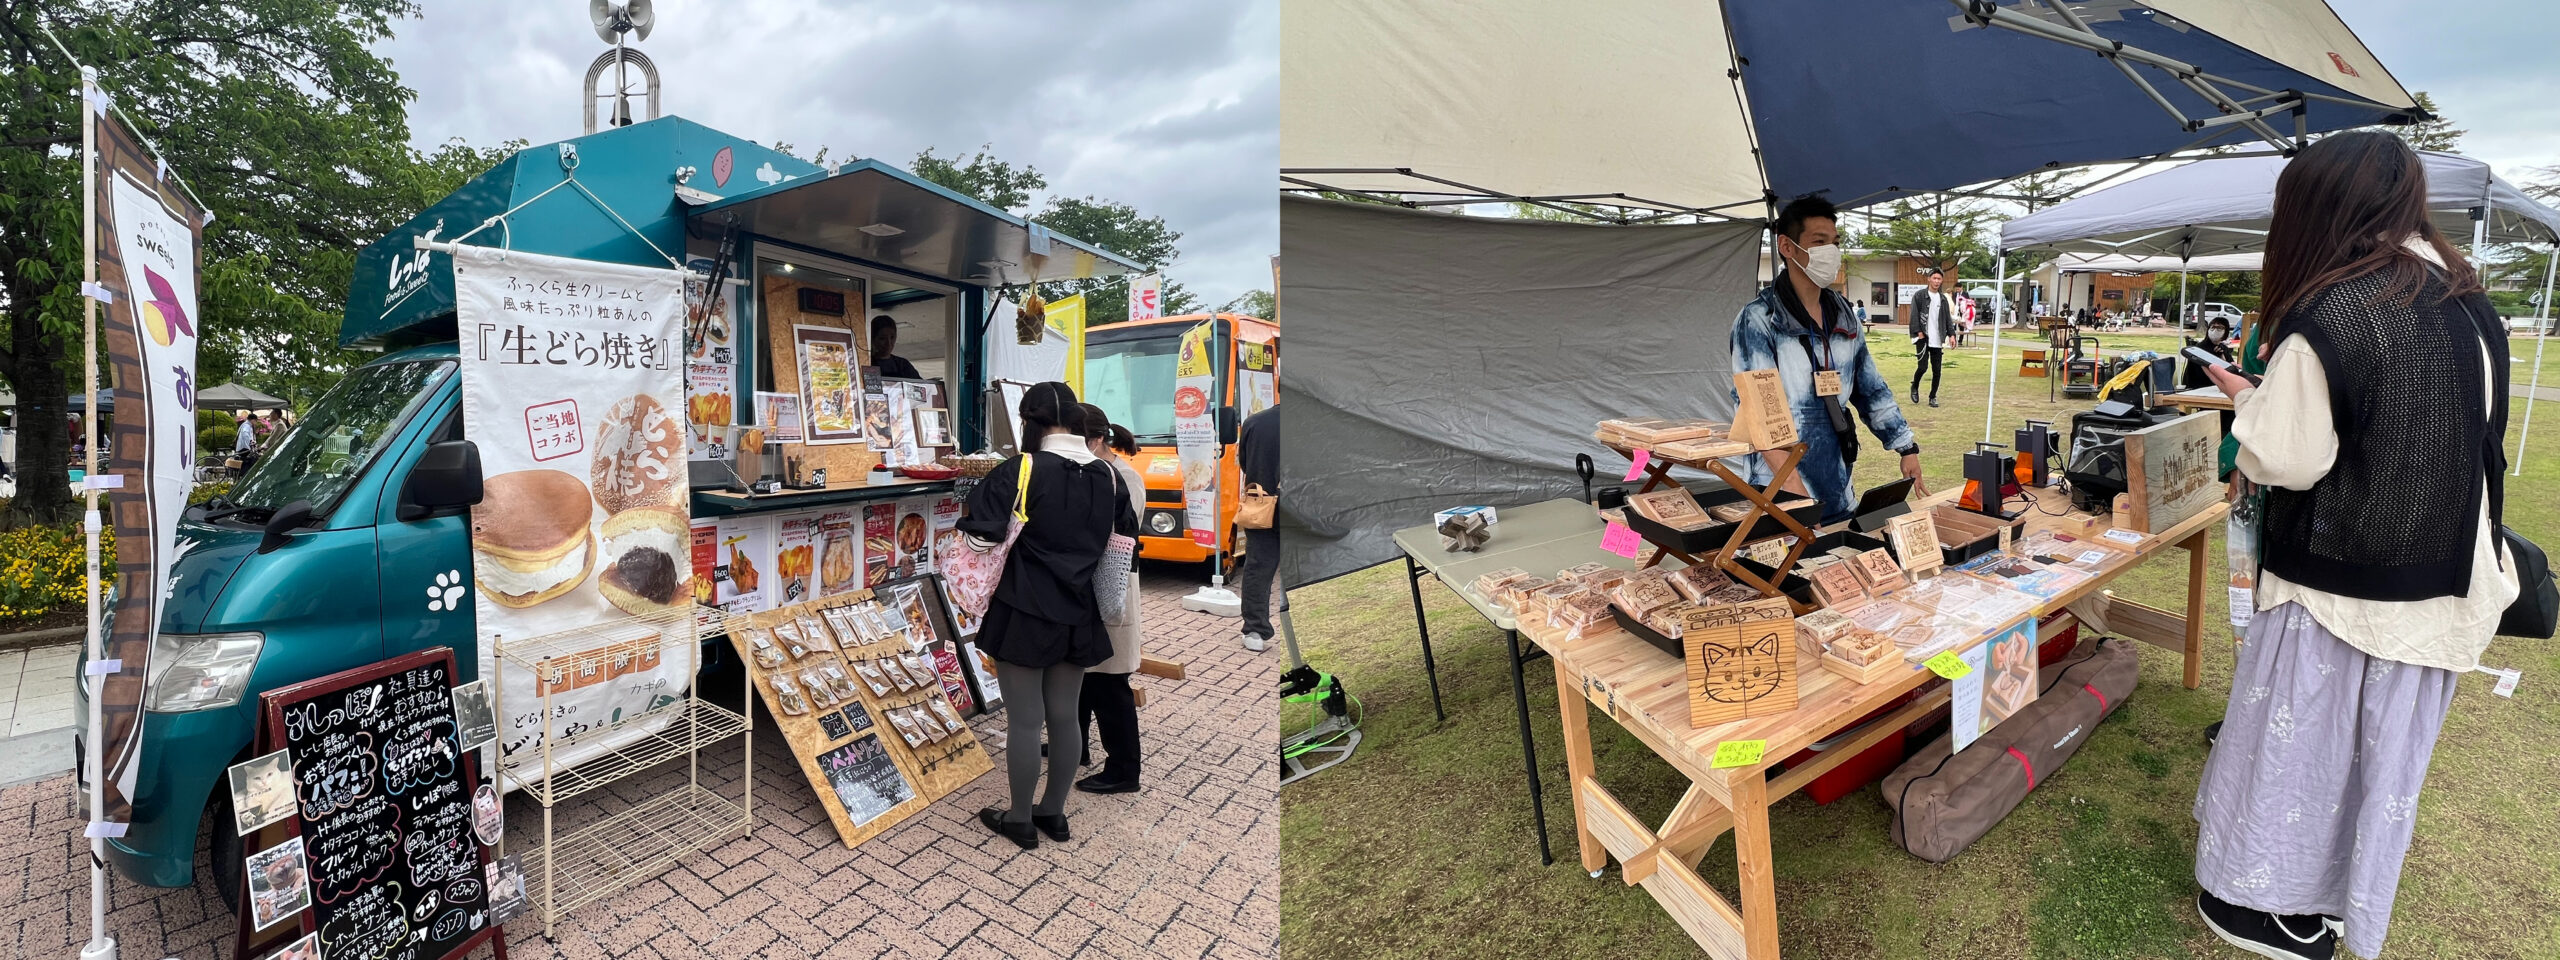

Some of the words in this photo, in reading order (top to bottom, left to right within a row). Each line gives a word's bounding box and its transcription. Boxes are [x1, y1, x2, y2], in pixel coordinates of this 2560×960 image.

[136, 233, 175, 270] sweets
[507, 276, 645, 302] ふっくら生クリームと
[503, 297, 652, 322] 風味たっぷり粒あんの
[479, 323, 669, 371] 『生どら焼き』
[532, 410, 576, 431] ご当地
[536, 430, 577, 449] コラボ
[388, 669, 443, 696] 社員達の
[306, 686, 376, 735] しっぽ
[394, 690, 437, 714] おすすめ
[360, 706, 390, 729] カンパニー
[303, 758, 328, 785] お芋
[387, 744, 431, 772] モンブラン
[390, 756, 439, 788] お芋ブリュレ
[412, 780, 460, 811] しっぽ限定
[356, 806, 382, 824] おすすめ
[320, 844, 358, 872] フルーツ
[327, 844, 388, 889] スカッシュドリンク
[350, 903, 377, 921] おすすめ
[416, 891, 437, 917] フード
[335, 903, 391, 948] ホットサンド
[435, 911, 463, 939] ドリンク
